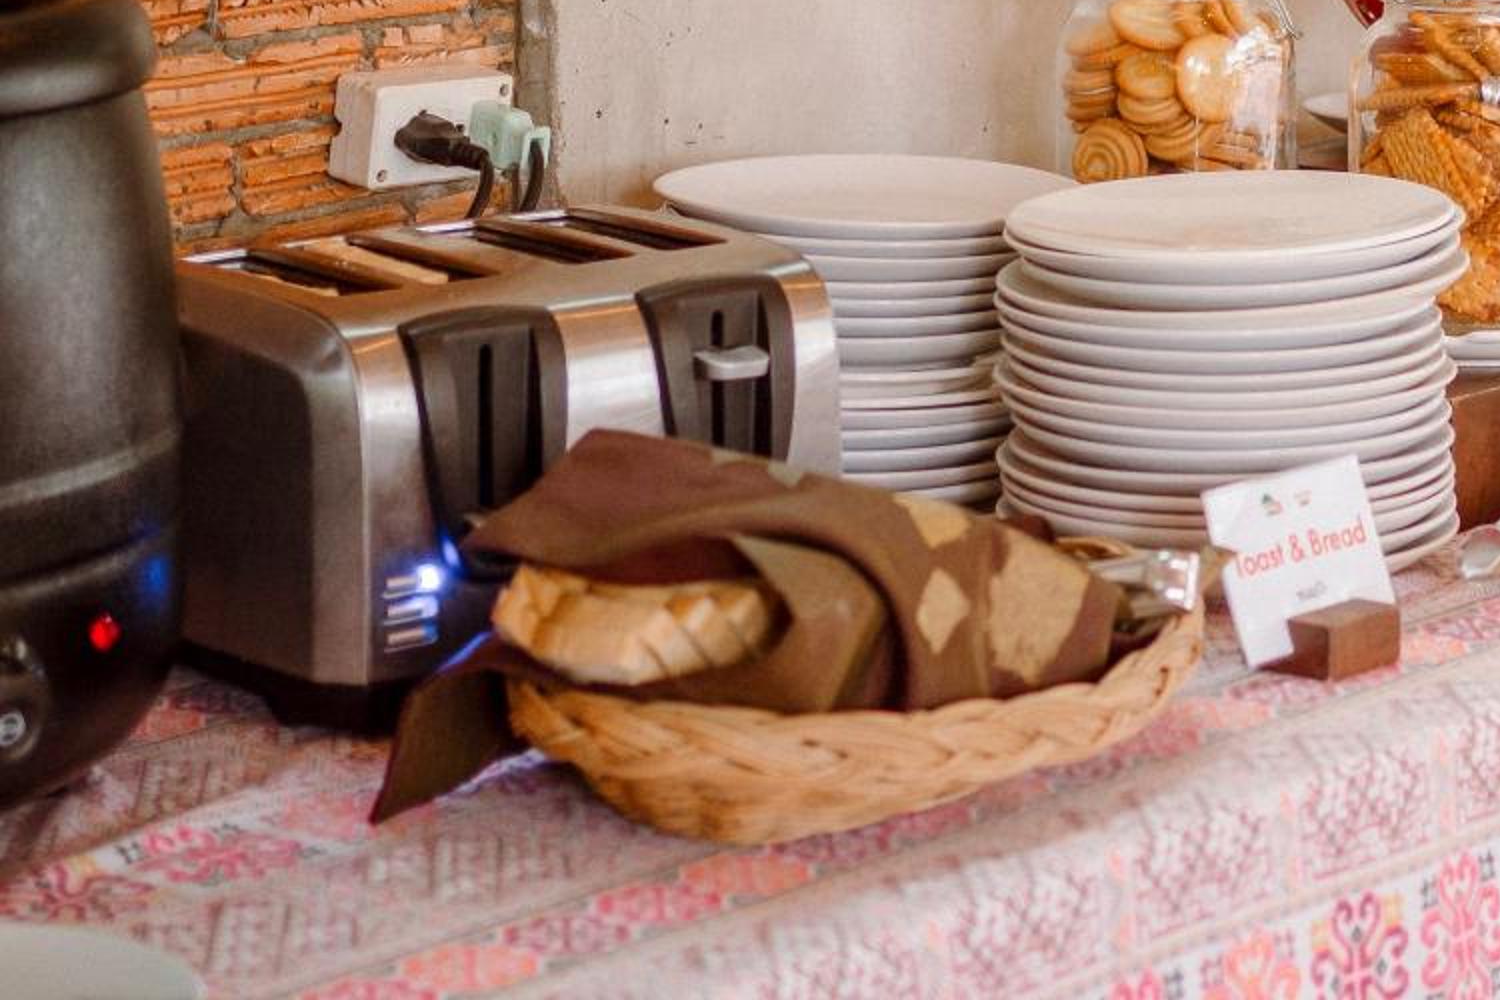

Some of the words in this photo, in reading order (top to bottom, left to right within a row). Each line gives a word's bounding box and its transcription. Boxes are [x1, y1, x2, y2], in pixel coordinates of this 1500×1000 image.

[1234, 543, 1284, 578] Toast
[1287, 534, 1306, 563] &
[1307, 513, 1367, 556] Bread
